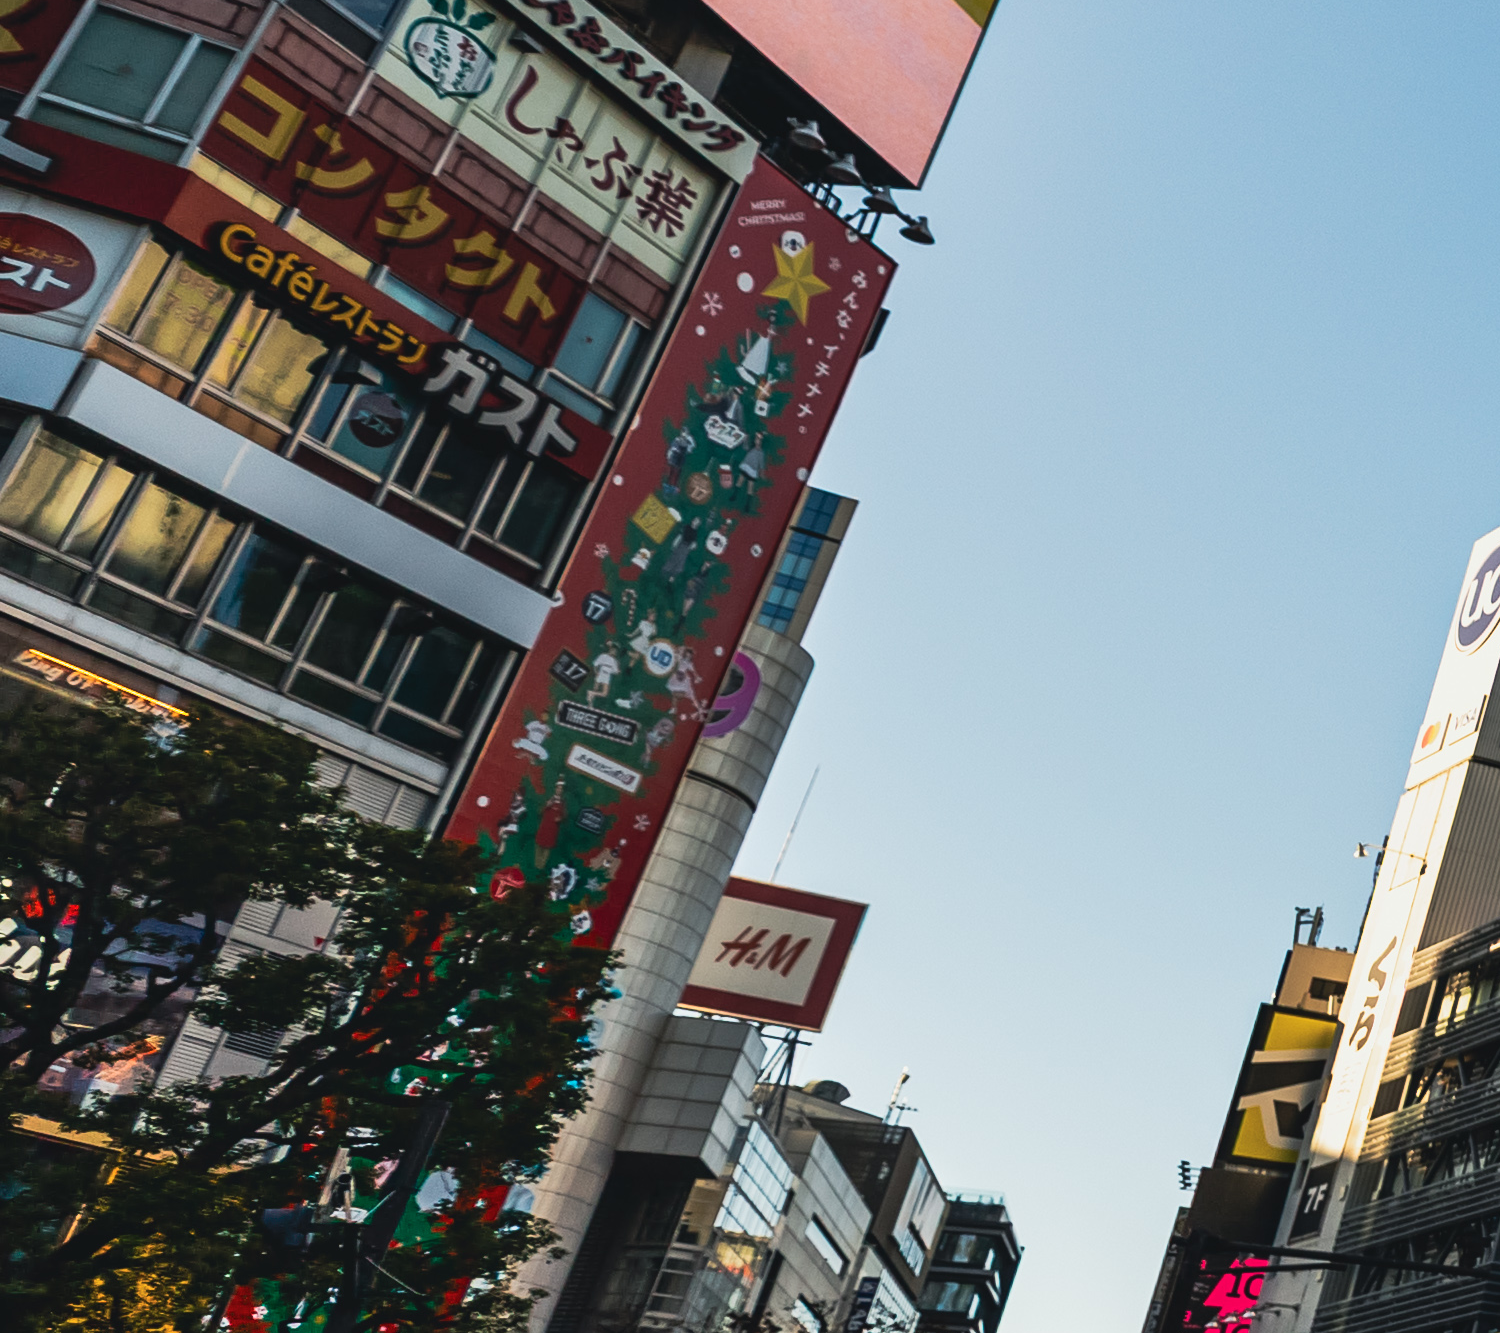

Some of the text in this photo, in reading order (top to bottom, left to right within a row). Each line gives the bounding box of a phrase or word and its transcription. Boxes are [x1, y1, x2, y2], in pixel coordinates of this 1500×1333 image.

[218, 74, 557, 322] コンタクト
[505, 65, 698, 239] しゃぶ葉
[424, 344, 578, 458] ガスト
[714, 924, 812, 978] H&M
[1302, 1182, 1328, 1214] 7F
